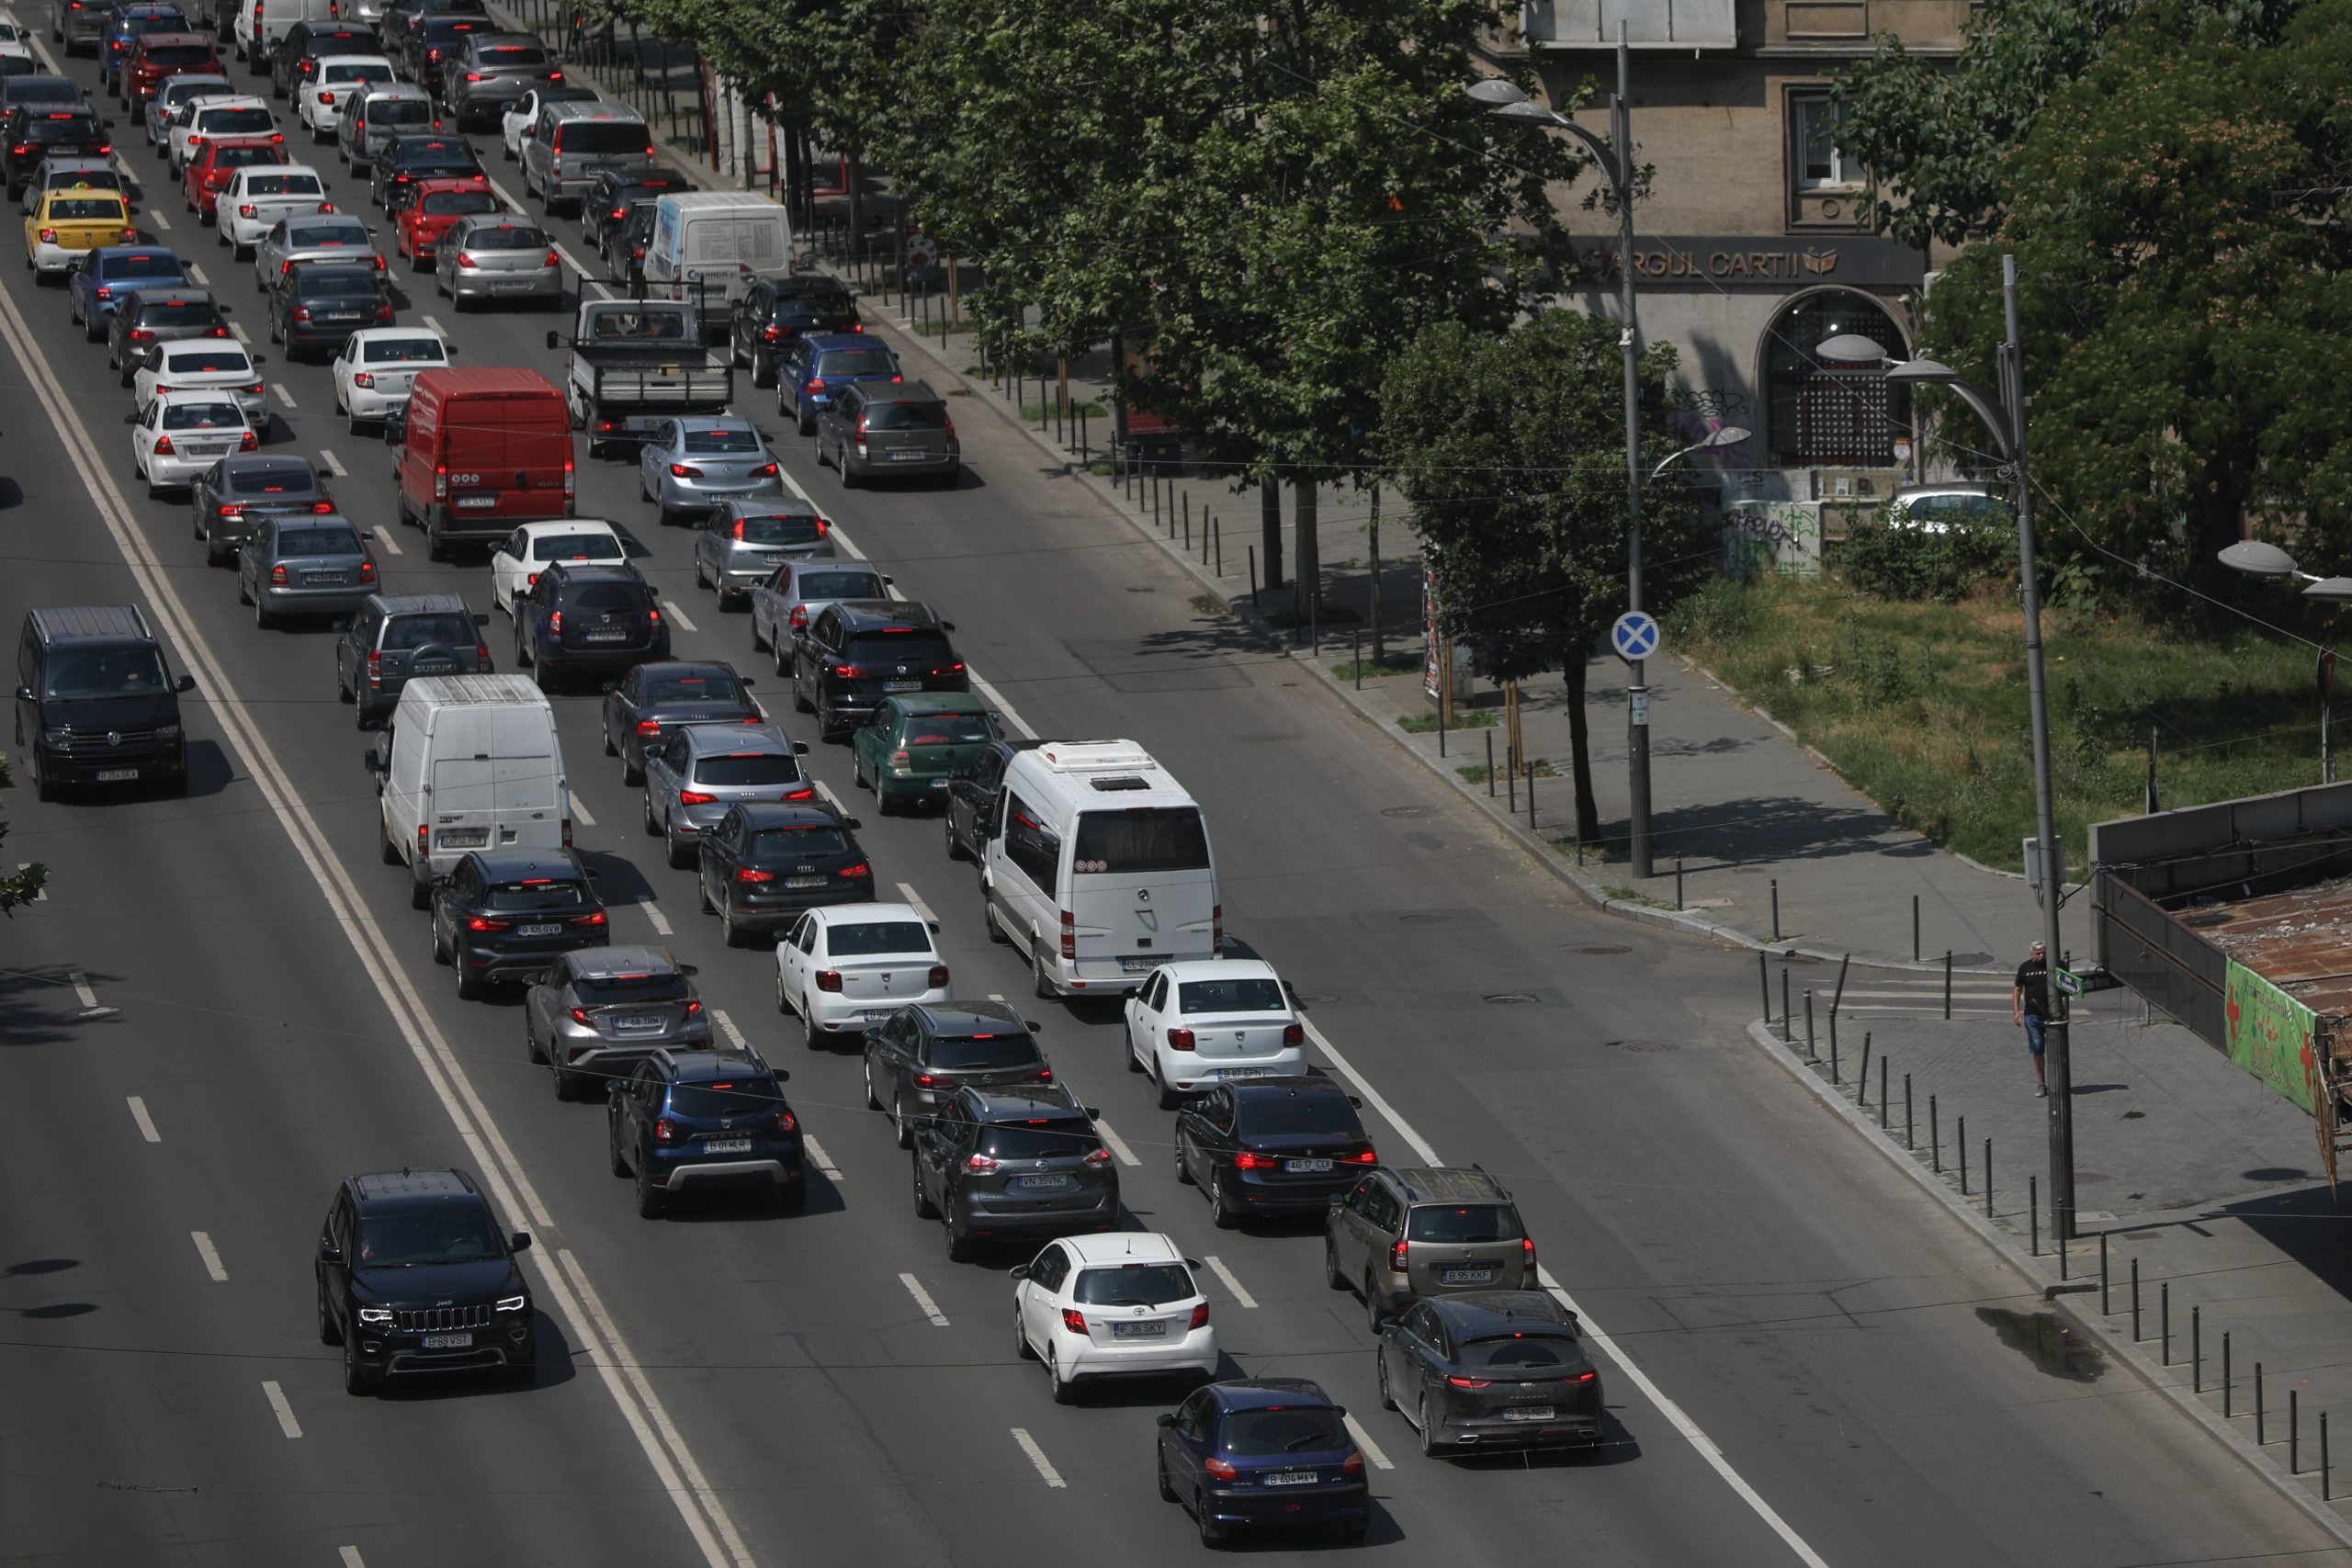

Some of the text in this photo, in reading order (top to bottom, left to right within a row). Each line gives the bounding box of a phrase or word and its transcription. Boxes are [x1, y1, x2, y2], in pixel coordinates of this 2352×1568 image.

[1708, 251, 1800, 278] CARTII
[413, 663, 458, 672] SUZUKI
[522, 924, 560, 934] B 105 GVW
[869, 1010, 876, 1019] B
[1223, 1068, 1262, 1077] B 87 EPN
[709, 1142, 717, 1150] B
[1291, 1161, 1302, 1169] AG
[1305, 1160, 1312, 1168] 17
[1023, 1176, 1035, 1185] VN
[1449, 1270, 1489, 1280] B 95 KKF
[1131, 1325, 1141, 1333] 36
[1142, 1323, 1162, 1332] SKY
[428, 1336, 468, 1347] B 88 VST
[1507, 1409, 1514, 1418] B
[1270, 1472, 1316, 1484] B 404 MAY
